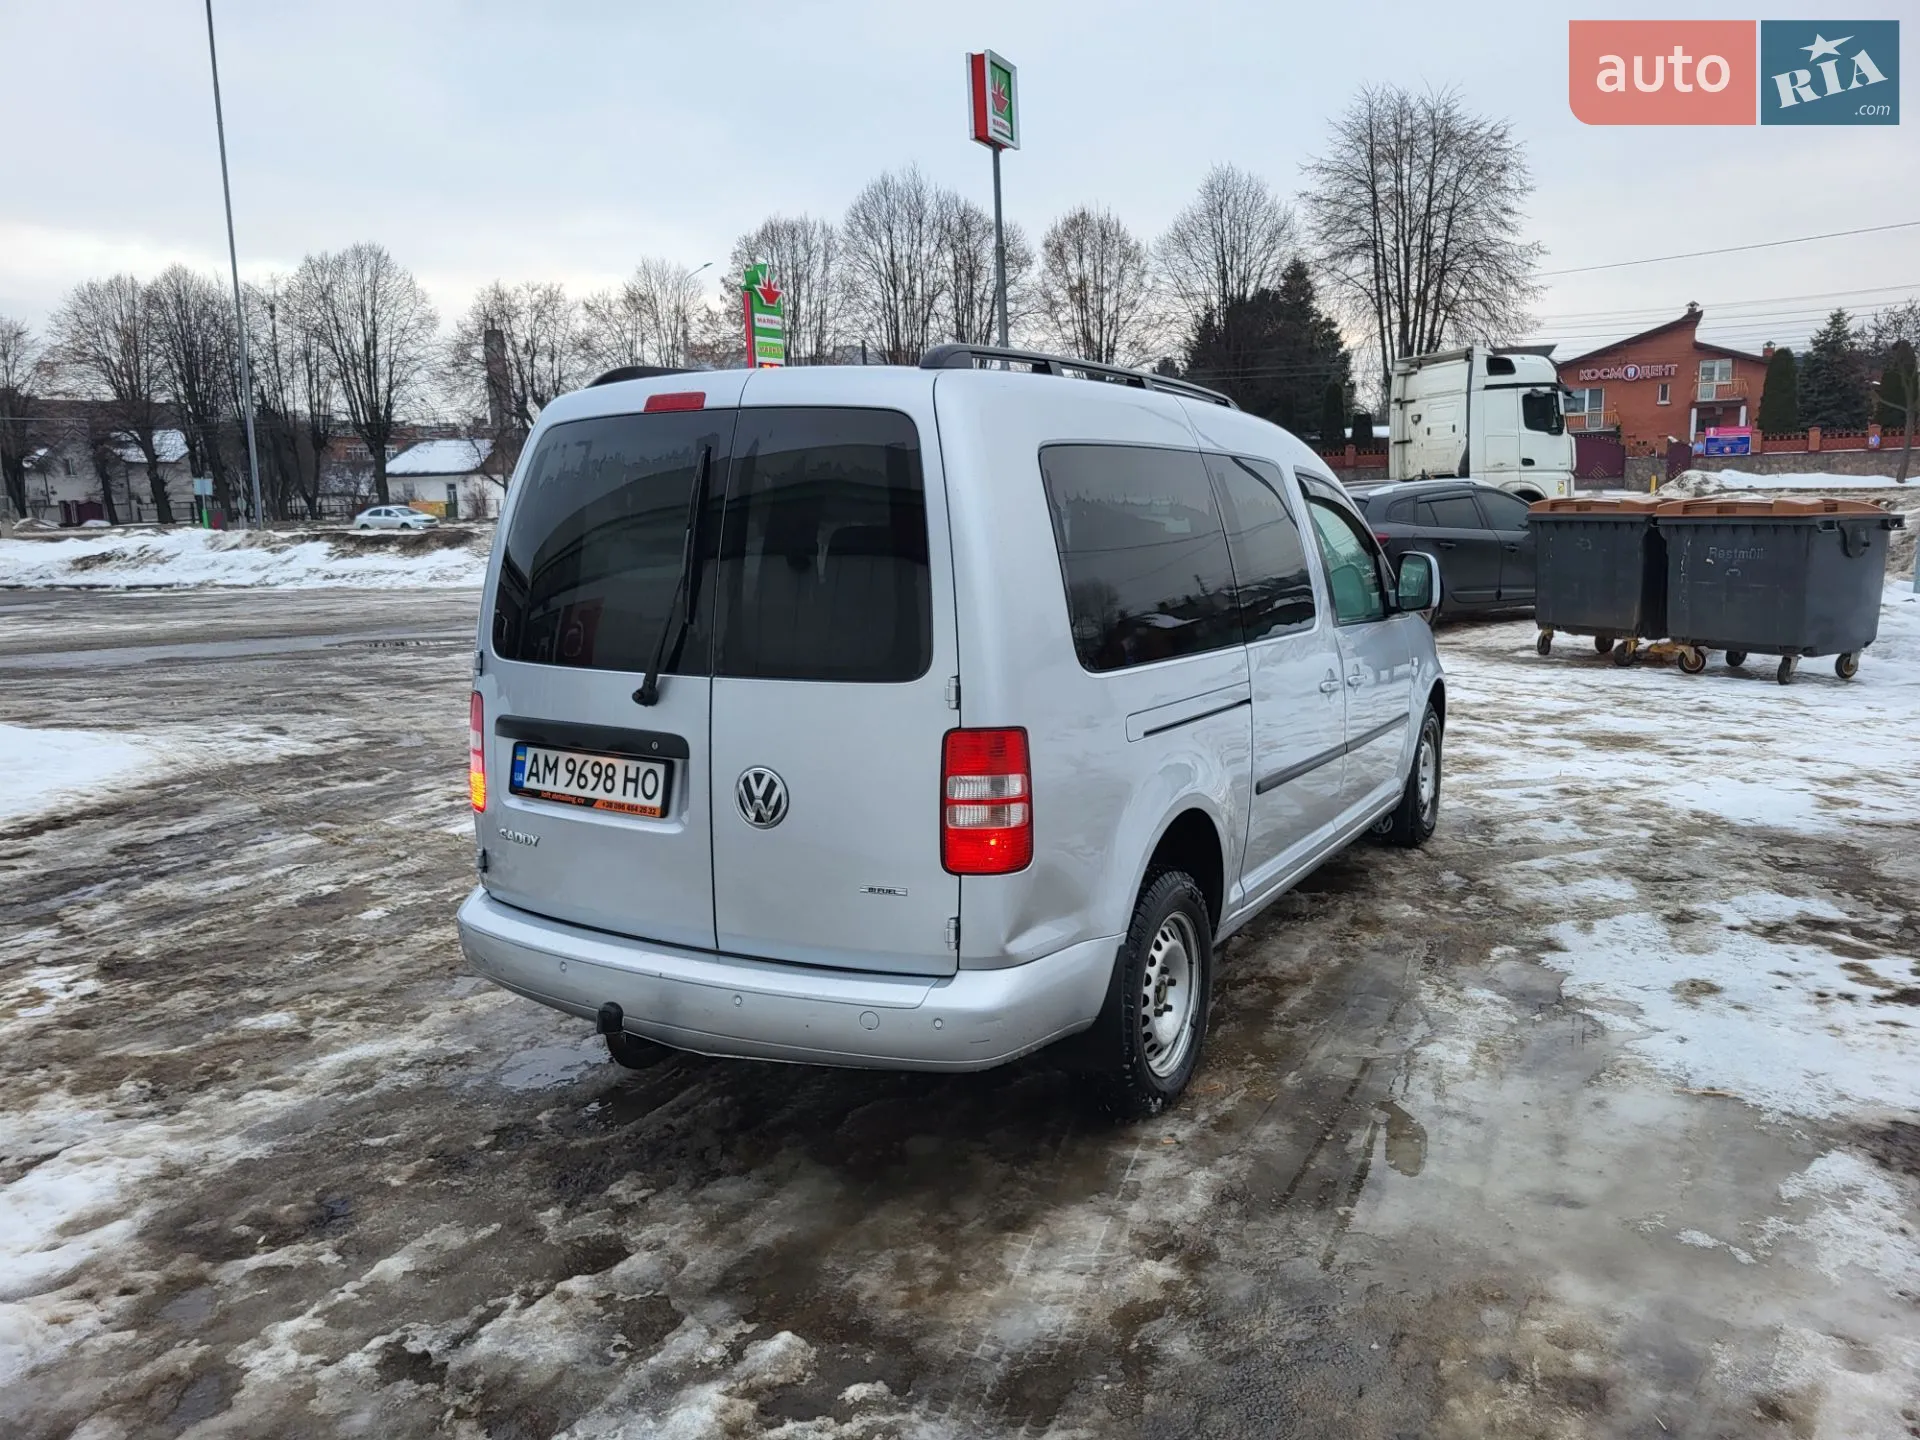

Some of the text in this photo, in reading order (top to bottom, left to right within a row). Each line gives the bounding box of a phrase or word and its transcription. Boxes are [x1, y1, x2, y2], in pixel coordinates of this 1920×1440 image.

[526, 752, 660, 801] AM 9698 HO
[499, 828, 541, 847] CADDY
